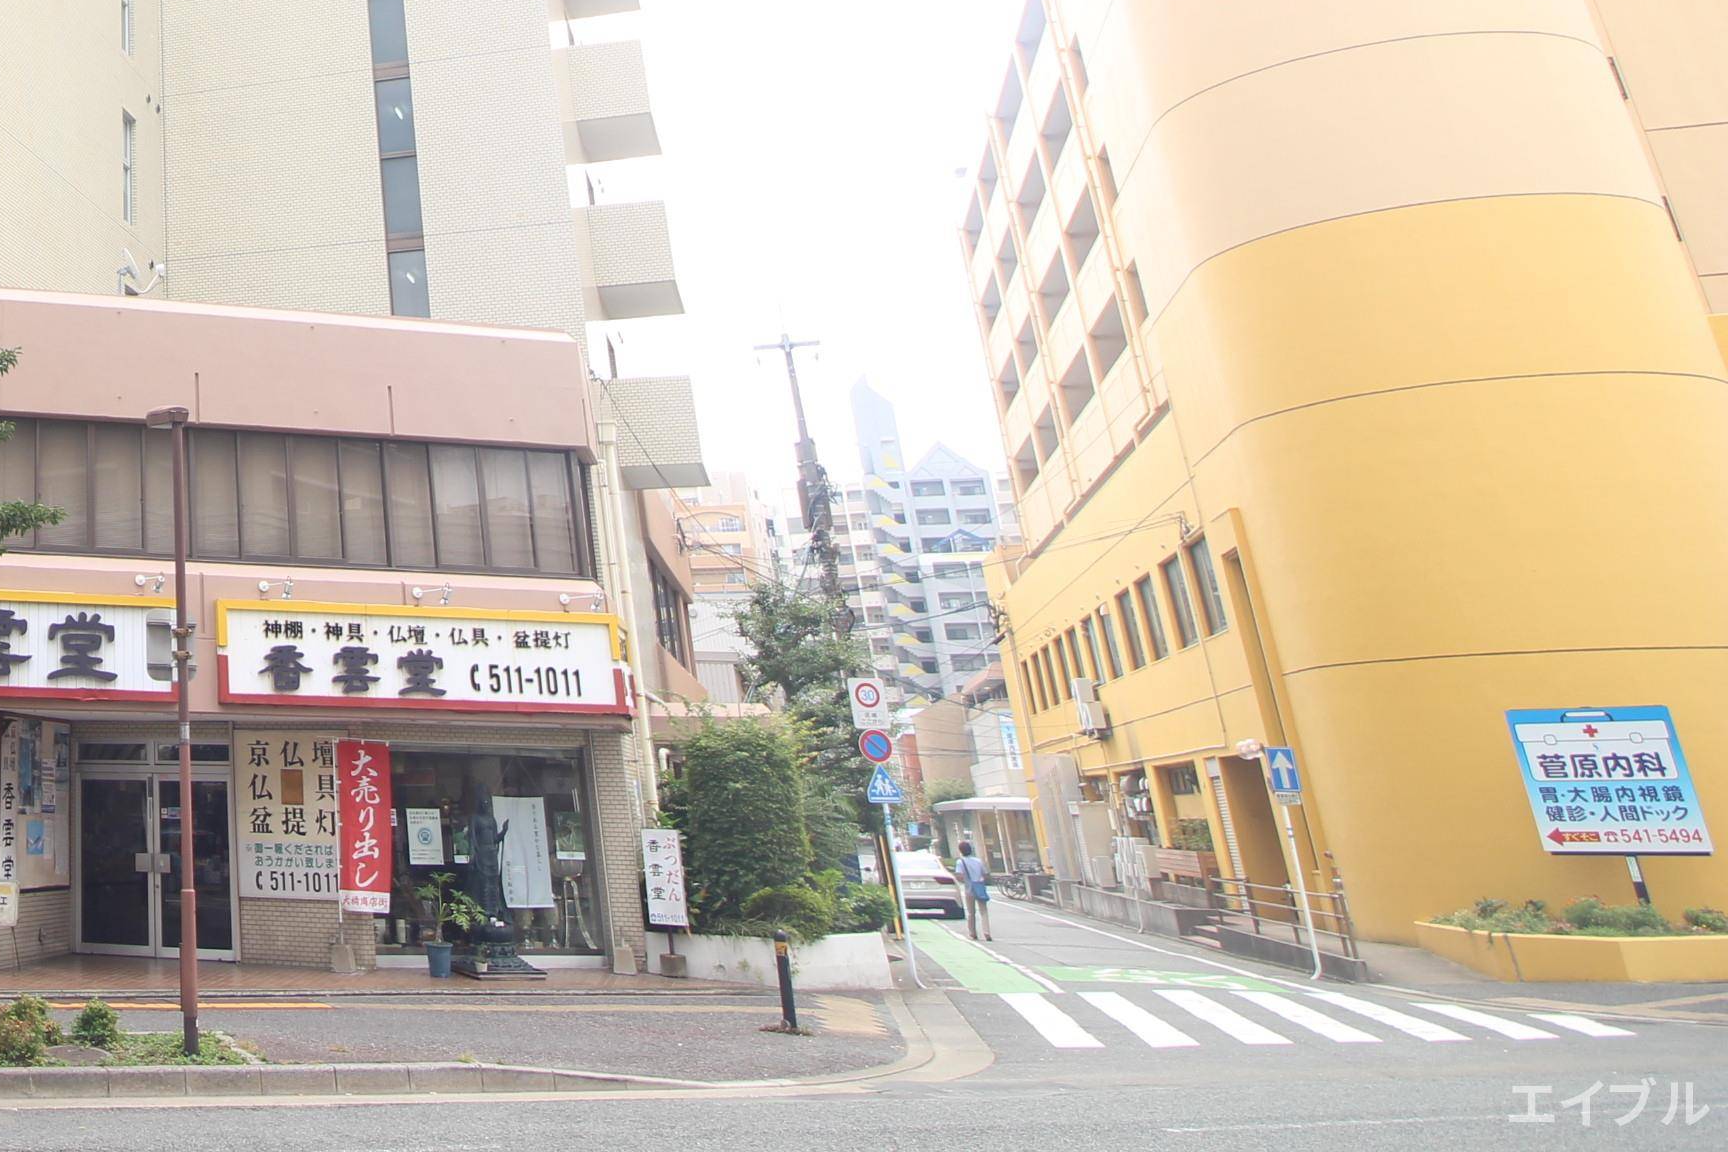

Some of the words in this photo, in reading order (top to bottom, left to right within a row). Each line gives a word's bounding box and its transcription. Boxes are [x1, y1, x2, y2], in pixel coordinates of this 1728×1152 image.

[489, 663, 582, 697] 511-1011
[860, 689, 875, 702] 30
[1536, 751, 1667, 779] 菅原内科
[1539, 785, 1685, 804] 胃・大腸内視鏡
[350, 749, 381, 888] 大売り出し
[1546, 804, 1689, 823] 健診・人間ドック
[1621, 828, 1703, 844] 541-5494
[255, 856, 339, 868] おうかがい致しま
[663, 837, 680, 902] ぶつだん
